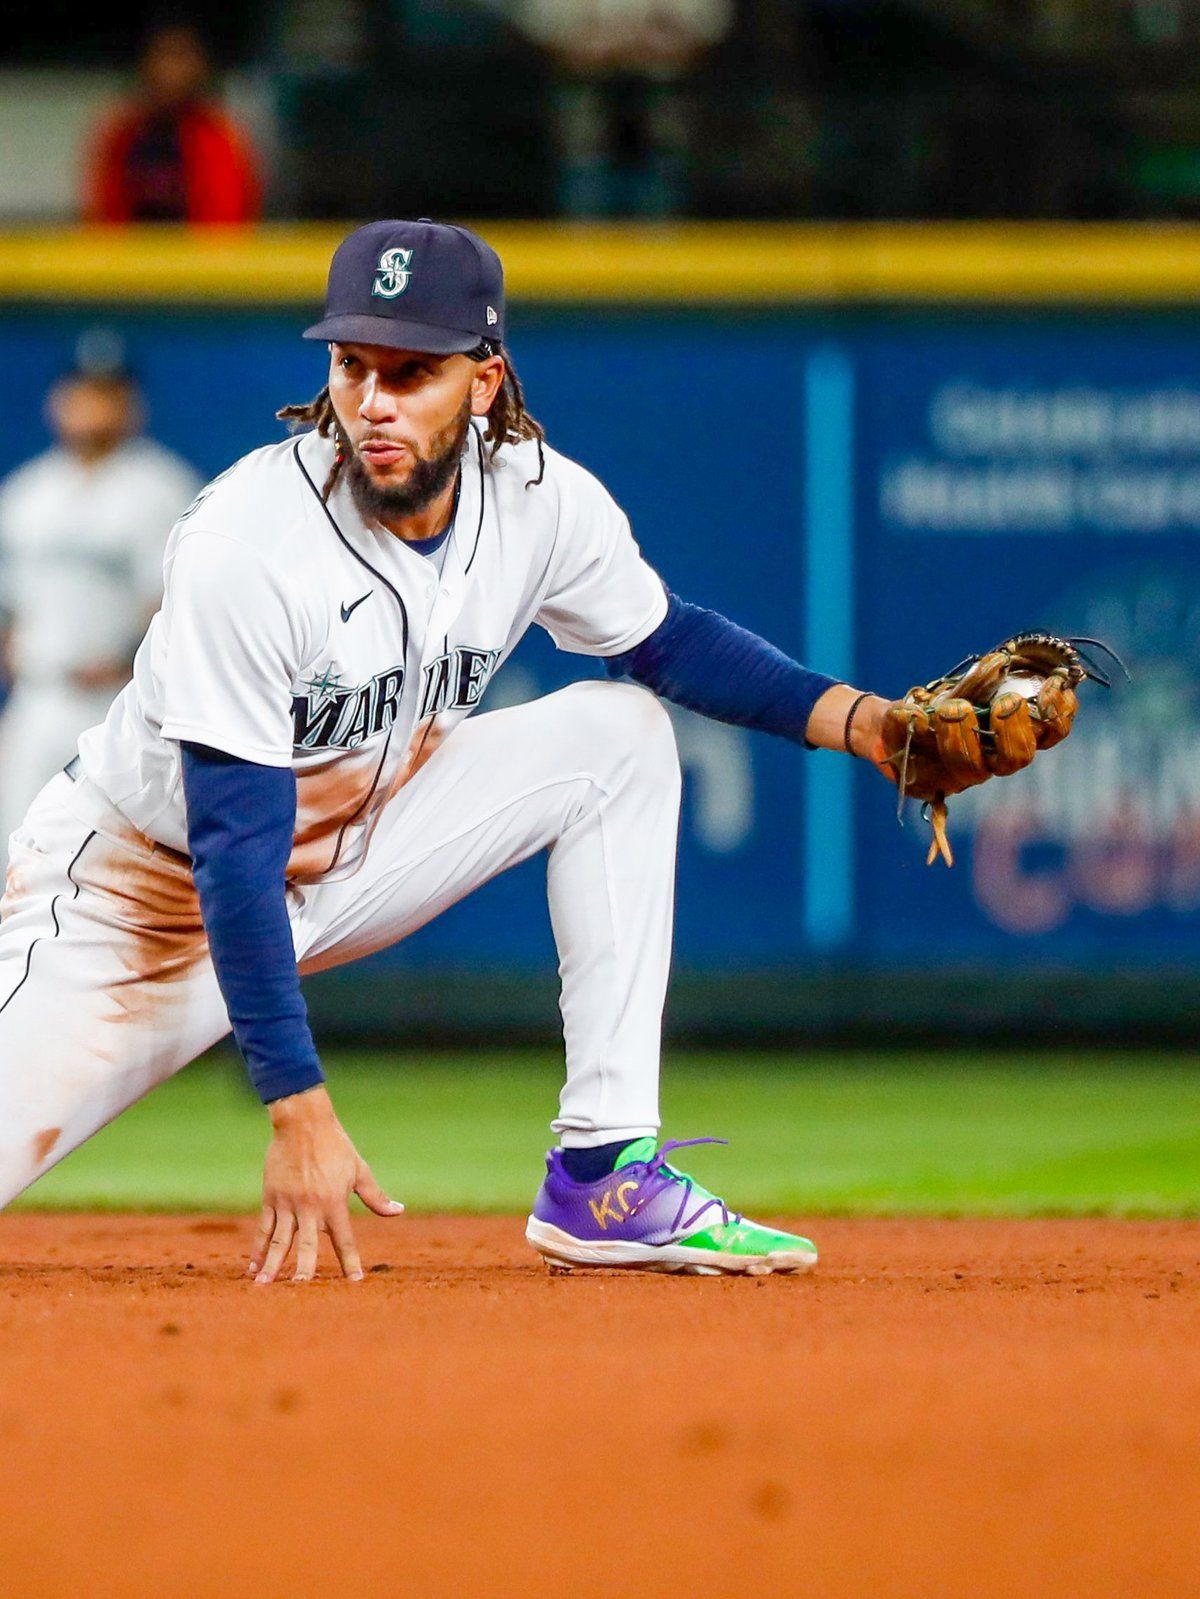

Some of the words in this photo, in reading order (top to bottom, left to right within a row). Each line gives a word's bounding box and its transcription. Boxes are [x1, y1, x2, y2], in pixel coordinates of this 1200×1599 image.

[371, 247, 413, 299] S
[288, 645, 504, 751] MARINE
[588, 1181, 639, 1231] KC
